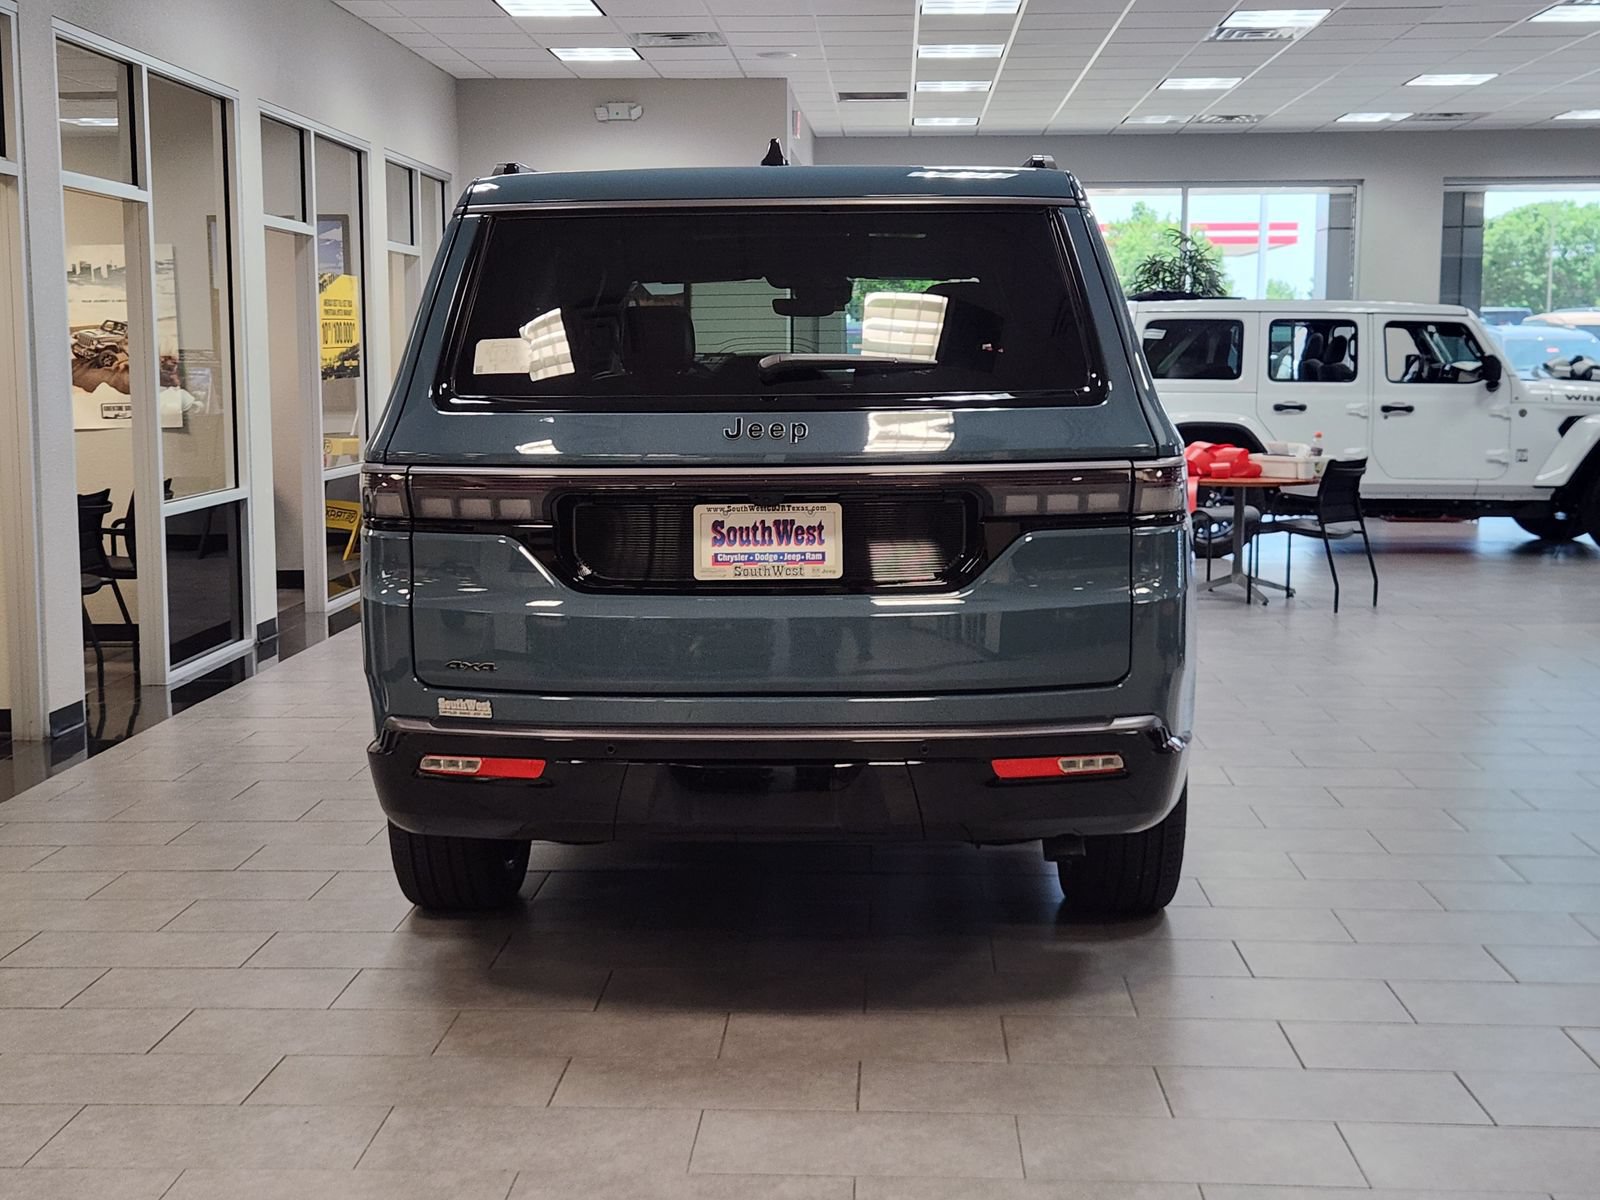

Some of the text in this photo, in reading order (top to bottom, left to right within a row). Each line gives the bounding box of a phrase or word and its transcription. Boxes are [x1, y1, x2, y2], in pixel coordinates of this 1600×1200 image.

[723, 417, 809, 443] Jeep
[711, 518, 825, 547] SouthWest
[717, 552, 823, 562] Chrysler Dodge Jeep Ram
[734, 564, 805, 577] SouthWest
